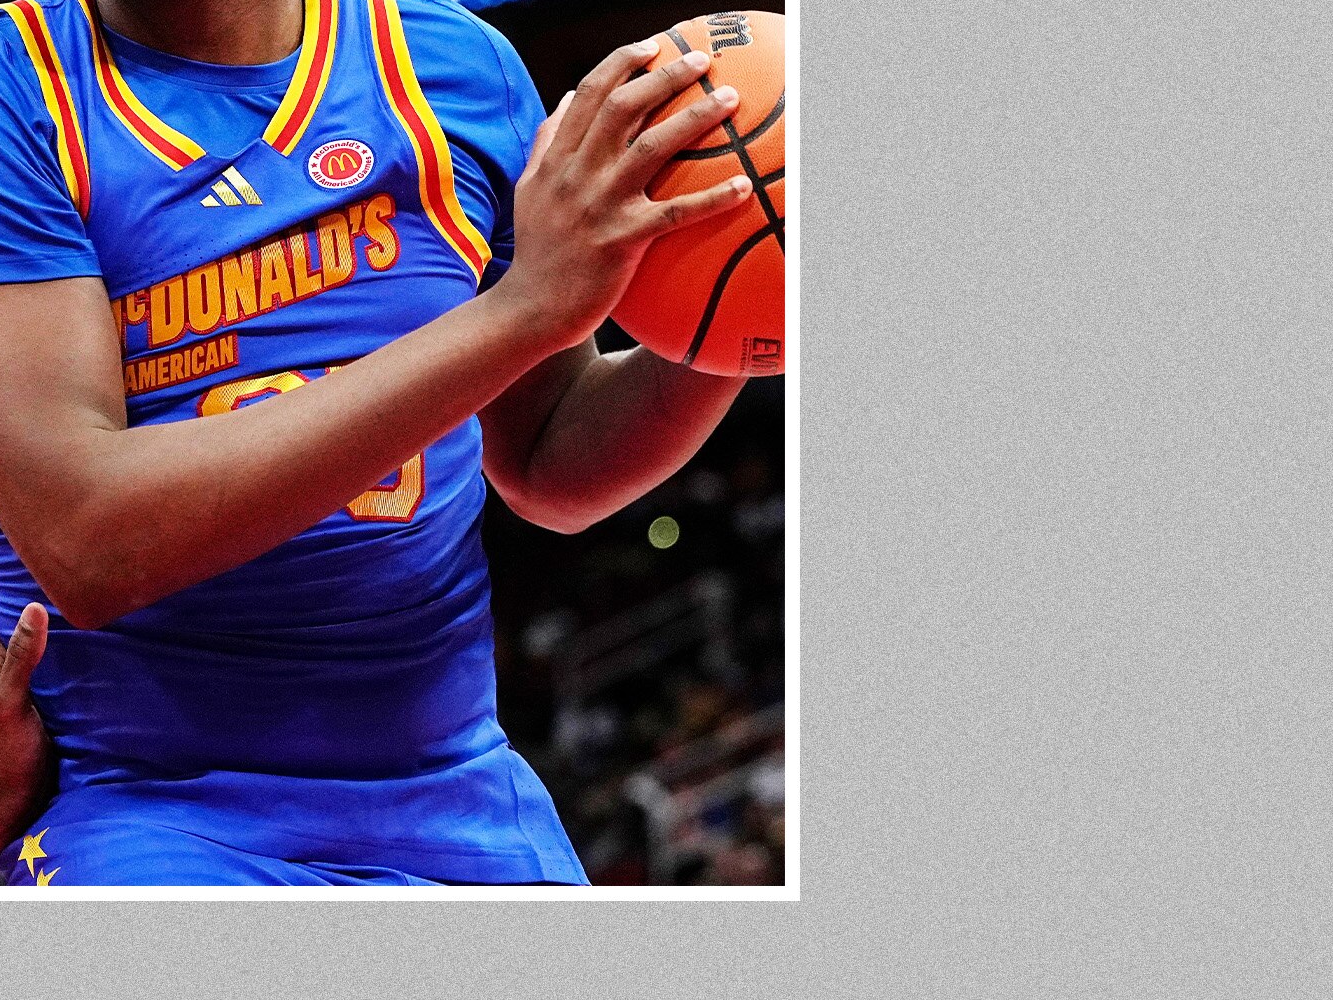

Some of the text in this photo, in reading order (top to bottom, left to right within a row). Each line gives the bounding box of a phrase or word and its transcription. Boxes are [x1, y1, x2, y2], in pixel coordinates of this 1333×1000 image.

[313, 141, 361, 160] McDonald's
[312, 156, 372, 187] All American Games
[123, 332, 235, 394] AMERICAN
